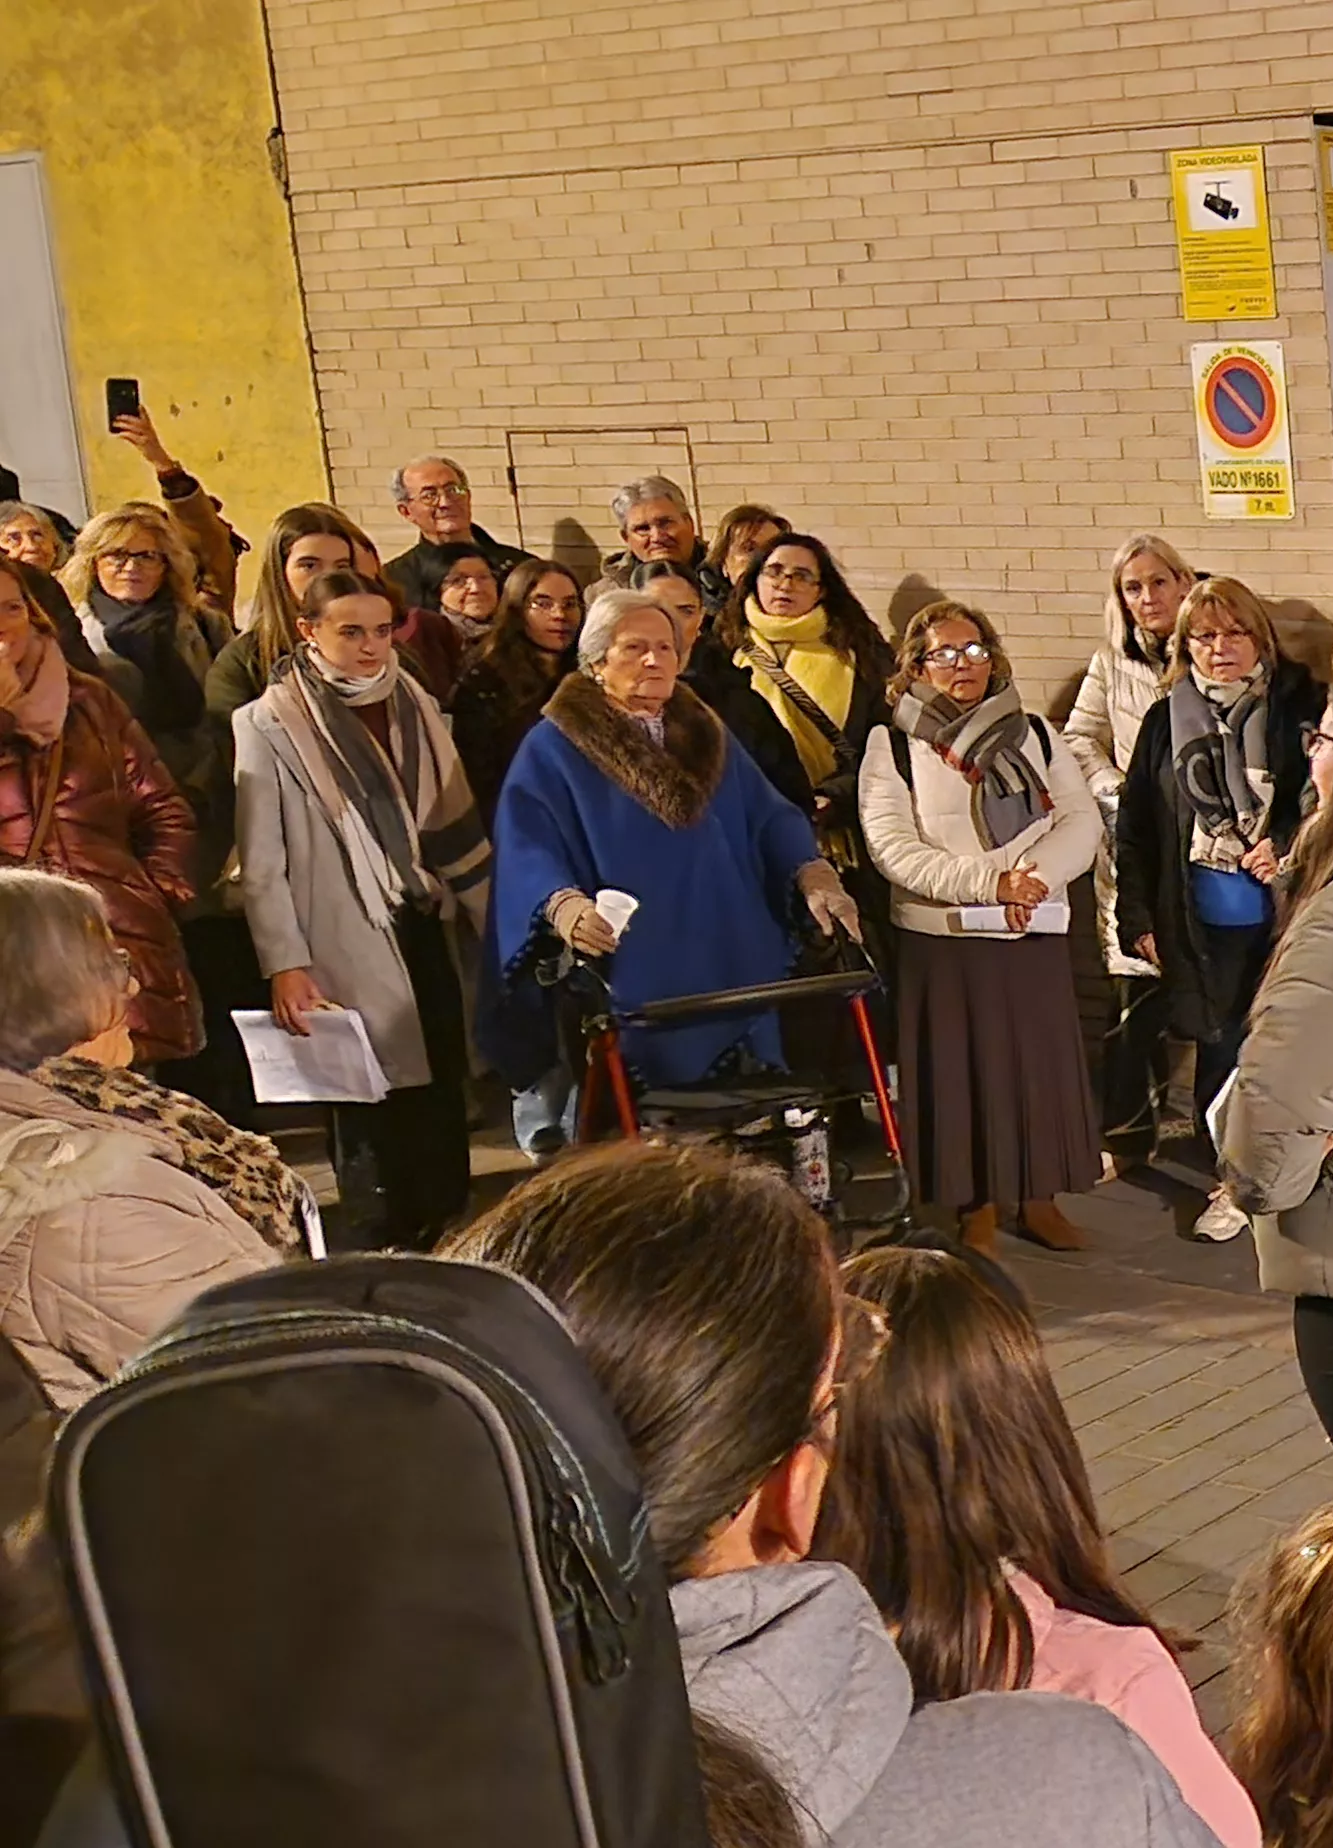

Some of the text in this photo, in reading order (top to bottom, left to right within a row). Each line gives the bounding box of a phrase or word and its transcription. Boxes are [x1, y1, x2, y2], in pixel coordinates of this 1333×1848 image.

[1177, 154, 1259, 168] ZONA VIDEOVIGILADA
[1223, 347, 1233, 356] DE
[1208, 470, 1238, 489] VADO
